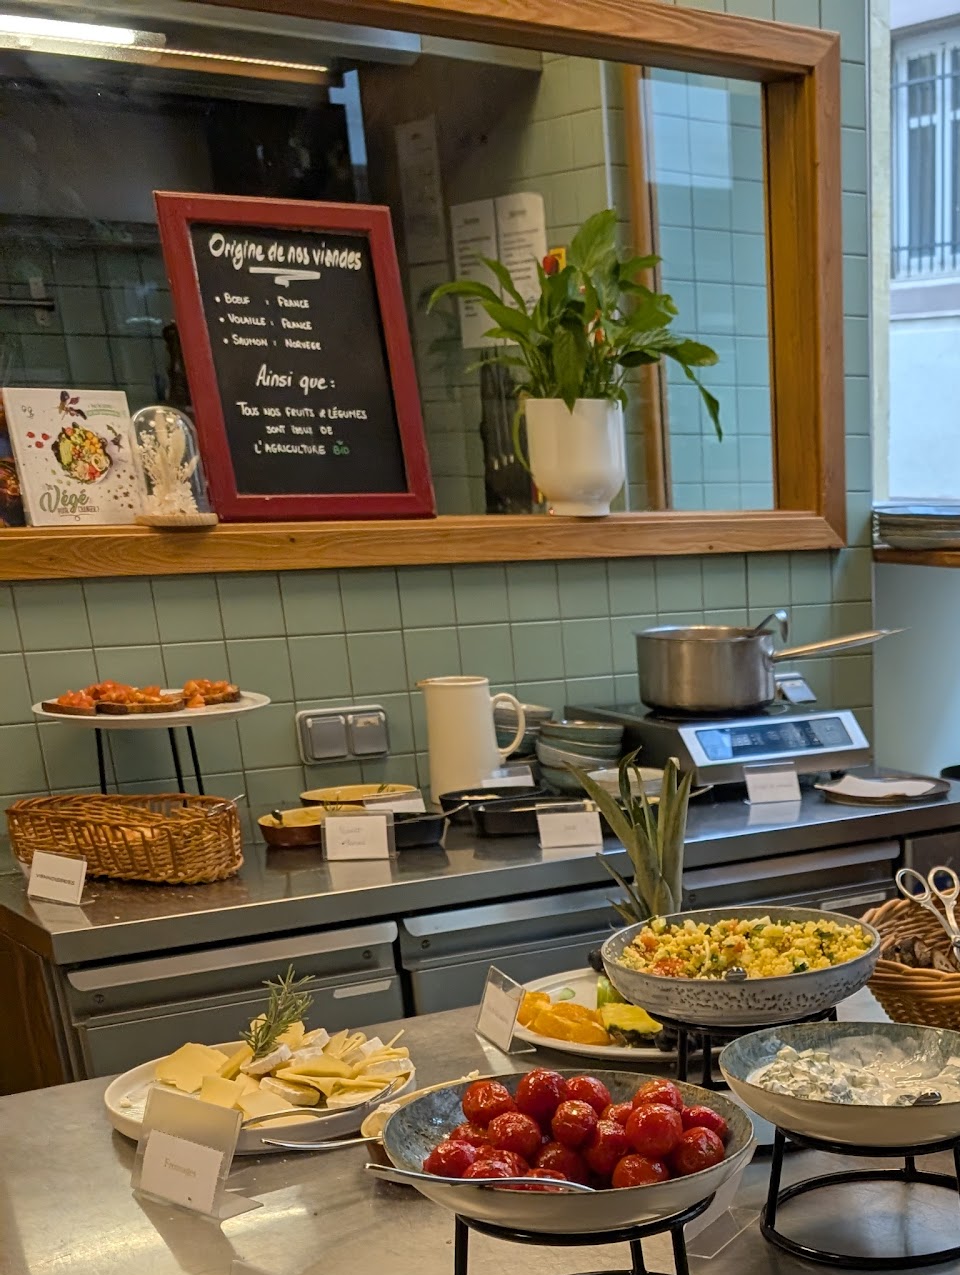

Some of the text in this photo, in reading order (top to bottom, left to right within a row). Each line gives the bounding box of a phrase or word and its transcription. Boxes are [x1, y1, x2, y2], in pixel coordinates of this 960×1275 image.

[209, 233, 265, 270] Origine
[268, 242, 285, 262] de
[287, 246, 310, 265] nos
[277, 296, 310, 308] FRANCE
[227, 313, 266, 326] VOLAILLE
[281, 318, 312, 330] FRANCE
[232, 334, 268, 346] SAUMON
[255, 364, 293, 387] Ainsi
[263, 408, 281, 417] NOS
[285, 406, 315, 418] FRUITS
[327, 406, 368, 420] LÉGUMES
[254, 440, 327, 455] L'AGRICULTURE
[39, 484, 90, 514] Végé
